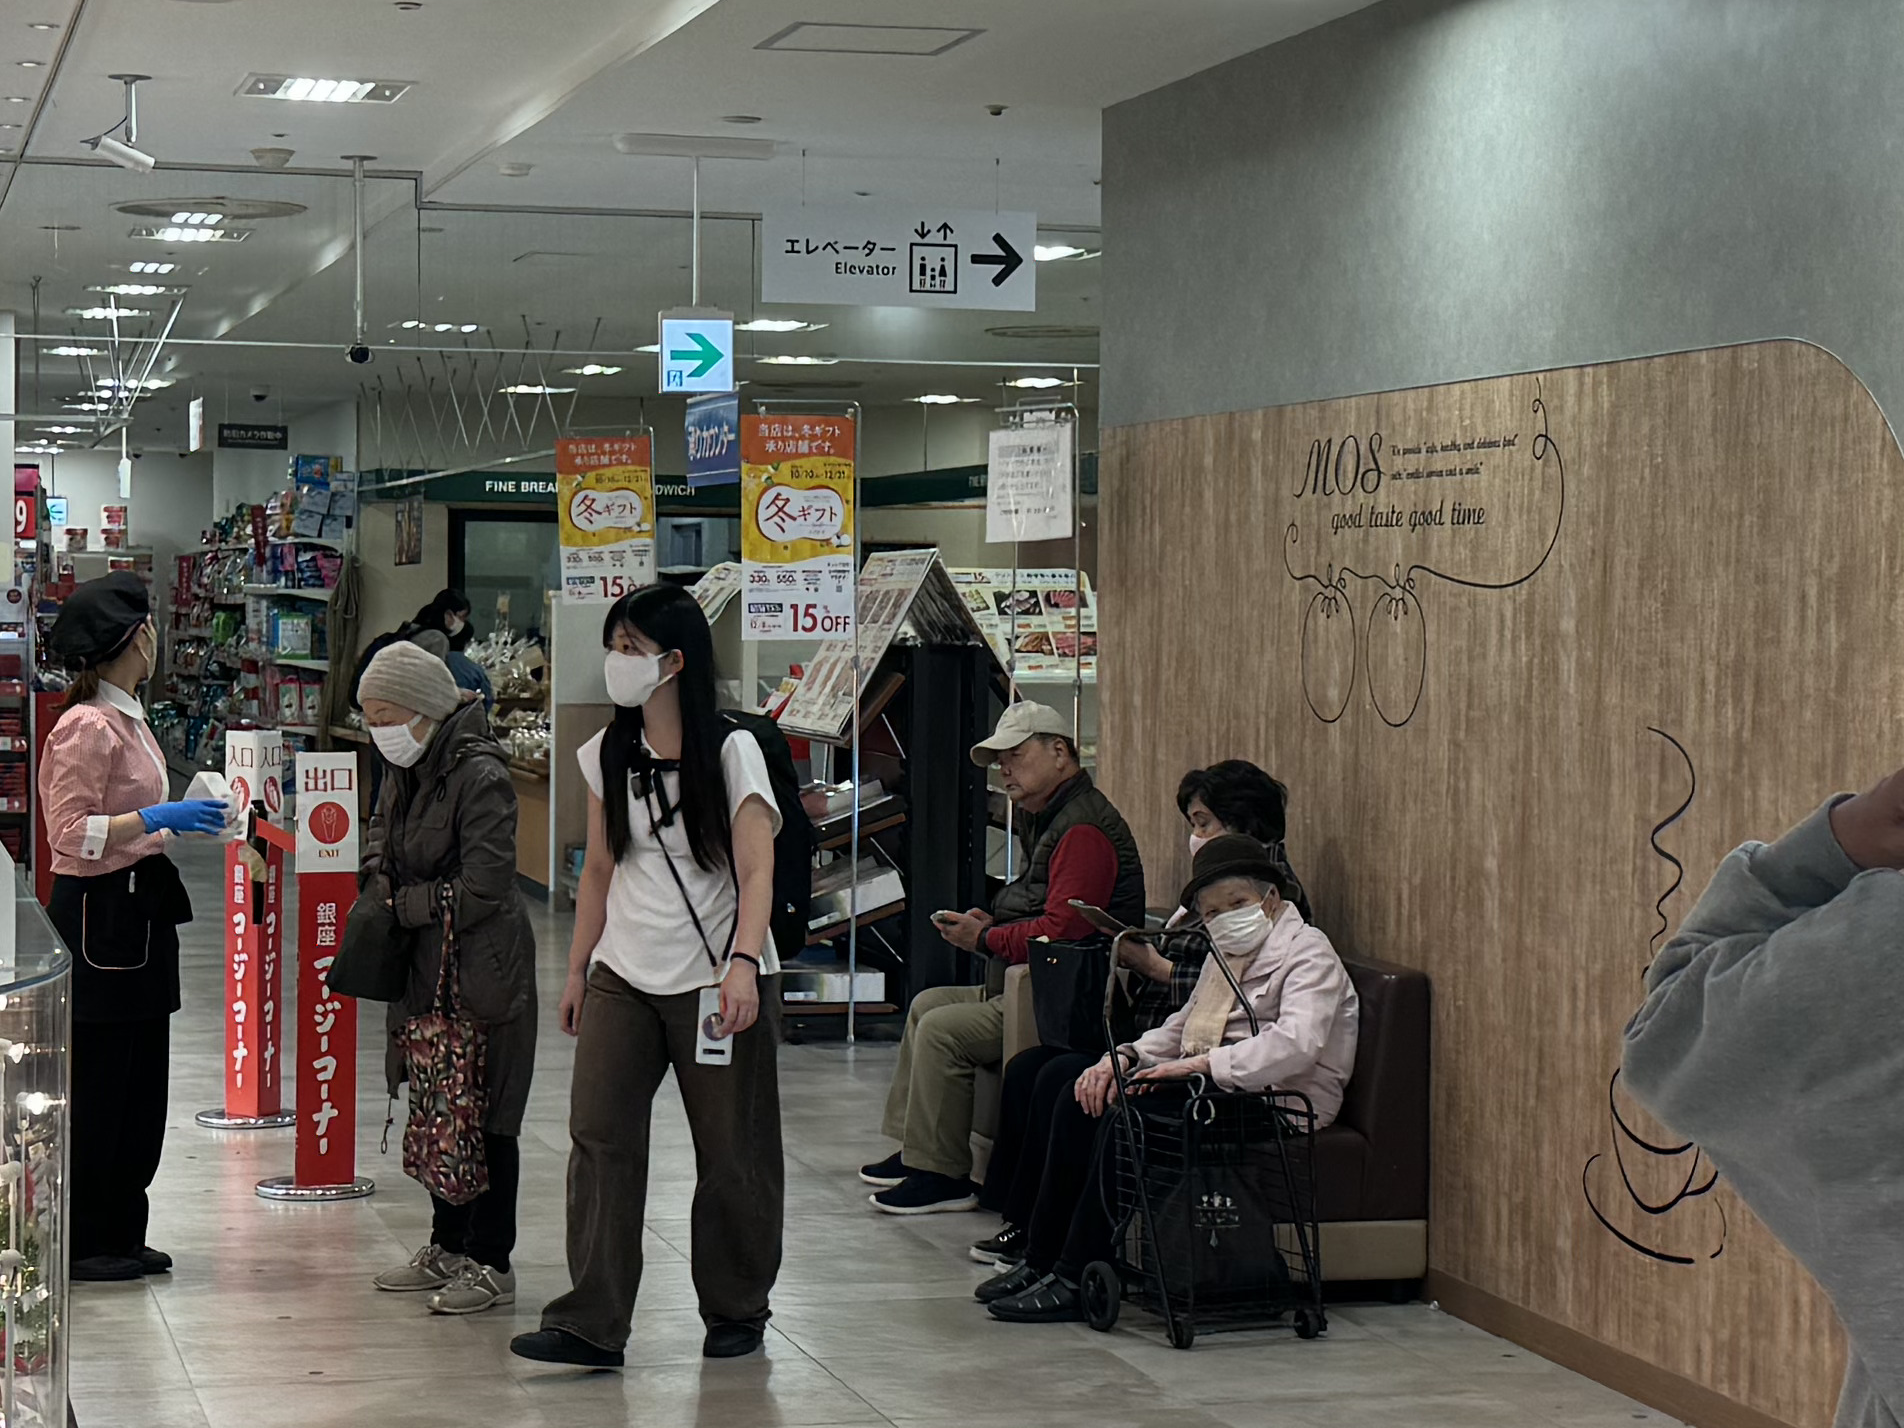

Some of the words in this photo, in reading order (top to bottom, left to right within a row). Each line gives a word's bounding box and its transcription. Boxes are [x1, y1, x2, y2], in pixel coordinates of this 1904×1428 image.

[785, 238, 896, 257] エレベーター
[835, 261, 896, 276] Elevator
[1293, 432, 1386, 498] MOS
[485, 481, 516, 492] FINE
[521, 481, 559, 493] BREA
[576, 494, 637, 525] 冬ギフト
[764, 492, 838, 534] 冬ギフト
[1331, 503, 1364, 535] good
[1369, 503, 1403, 528] taste
[1409, 499, 1444, 533] good
[1451, 501, 1485, 526] time
[821, 616, 851, 633] OFF
[229, 745, 253, 768] 入口
[260, 746, 281, 768] 入口
[305, 766, 352, 792] 出口
[318, 849, 339, 858] EXIT
